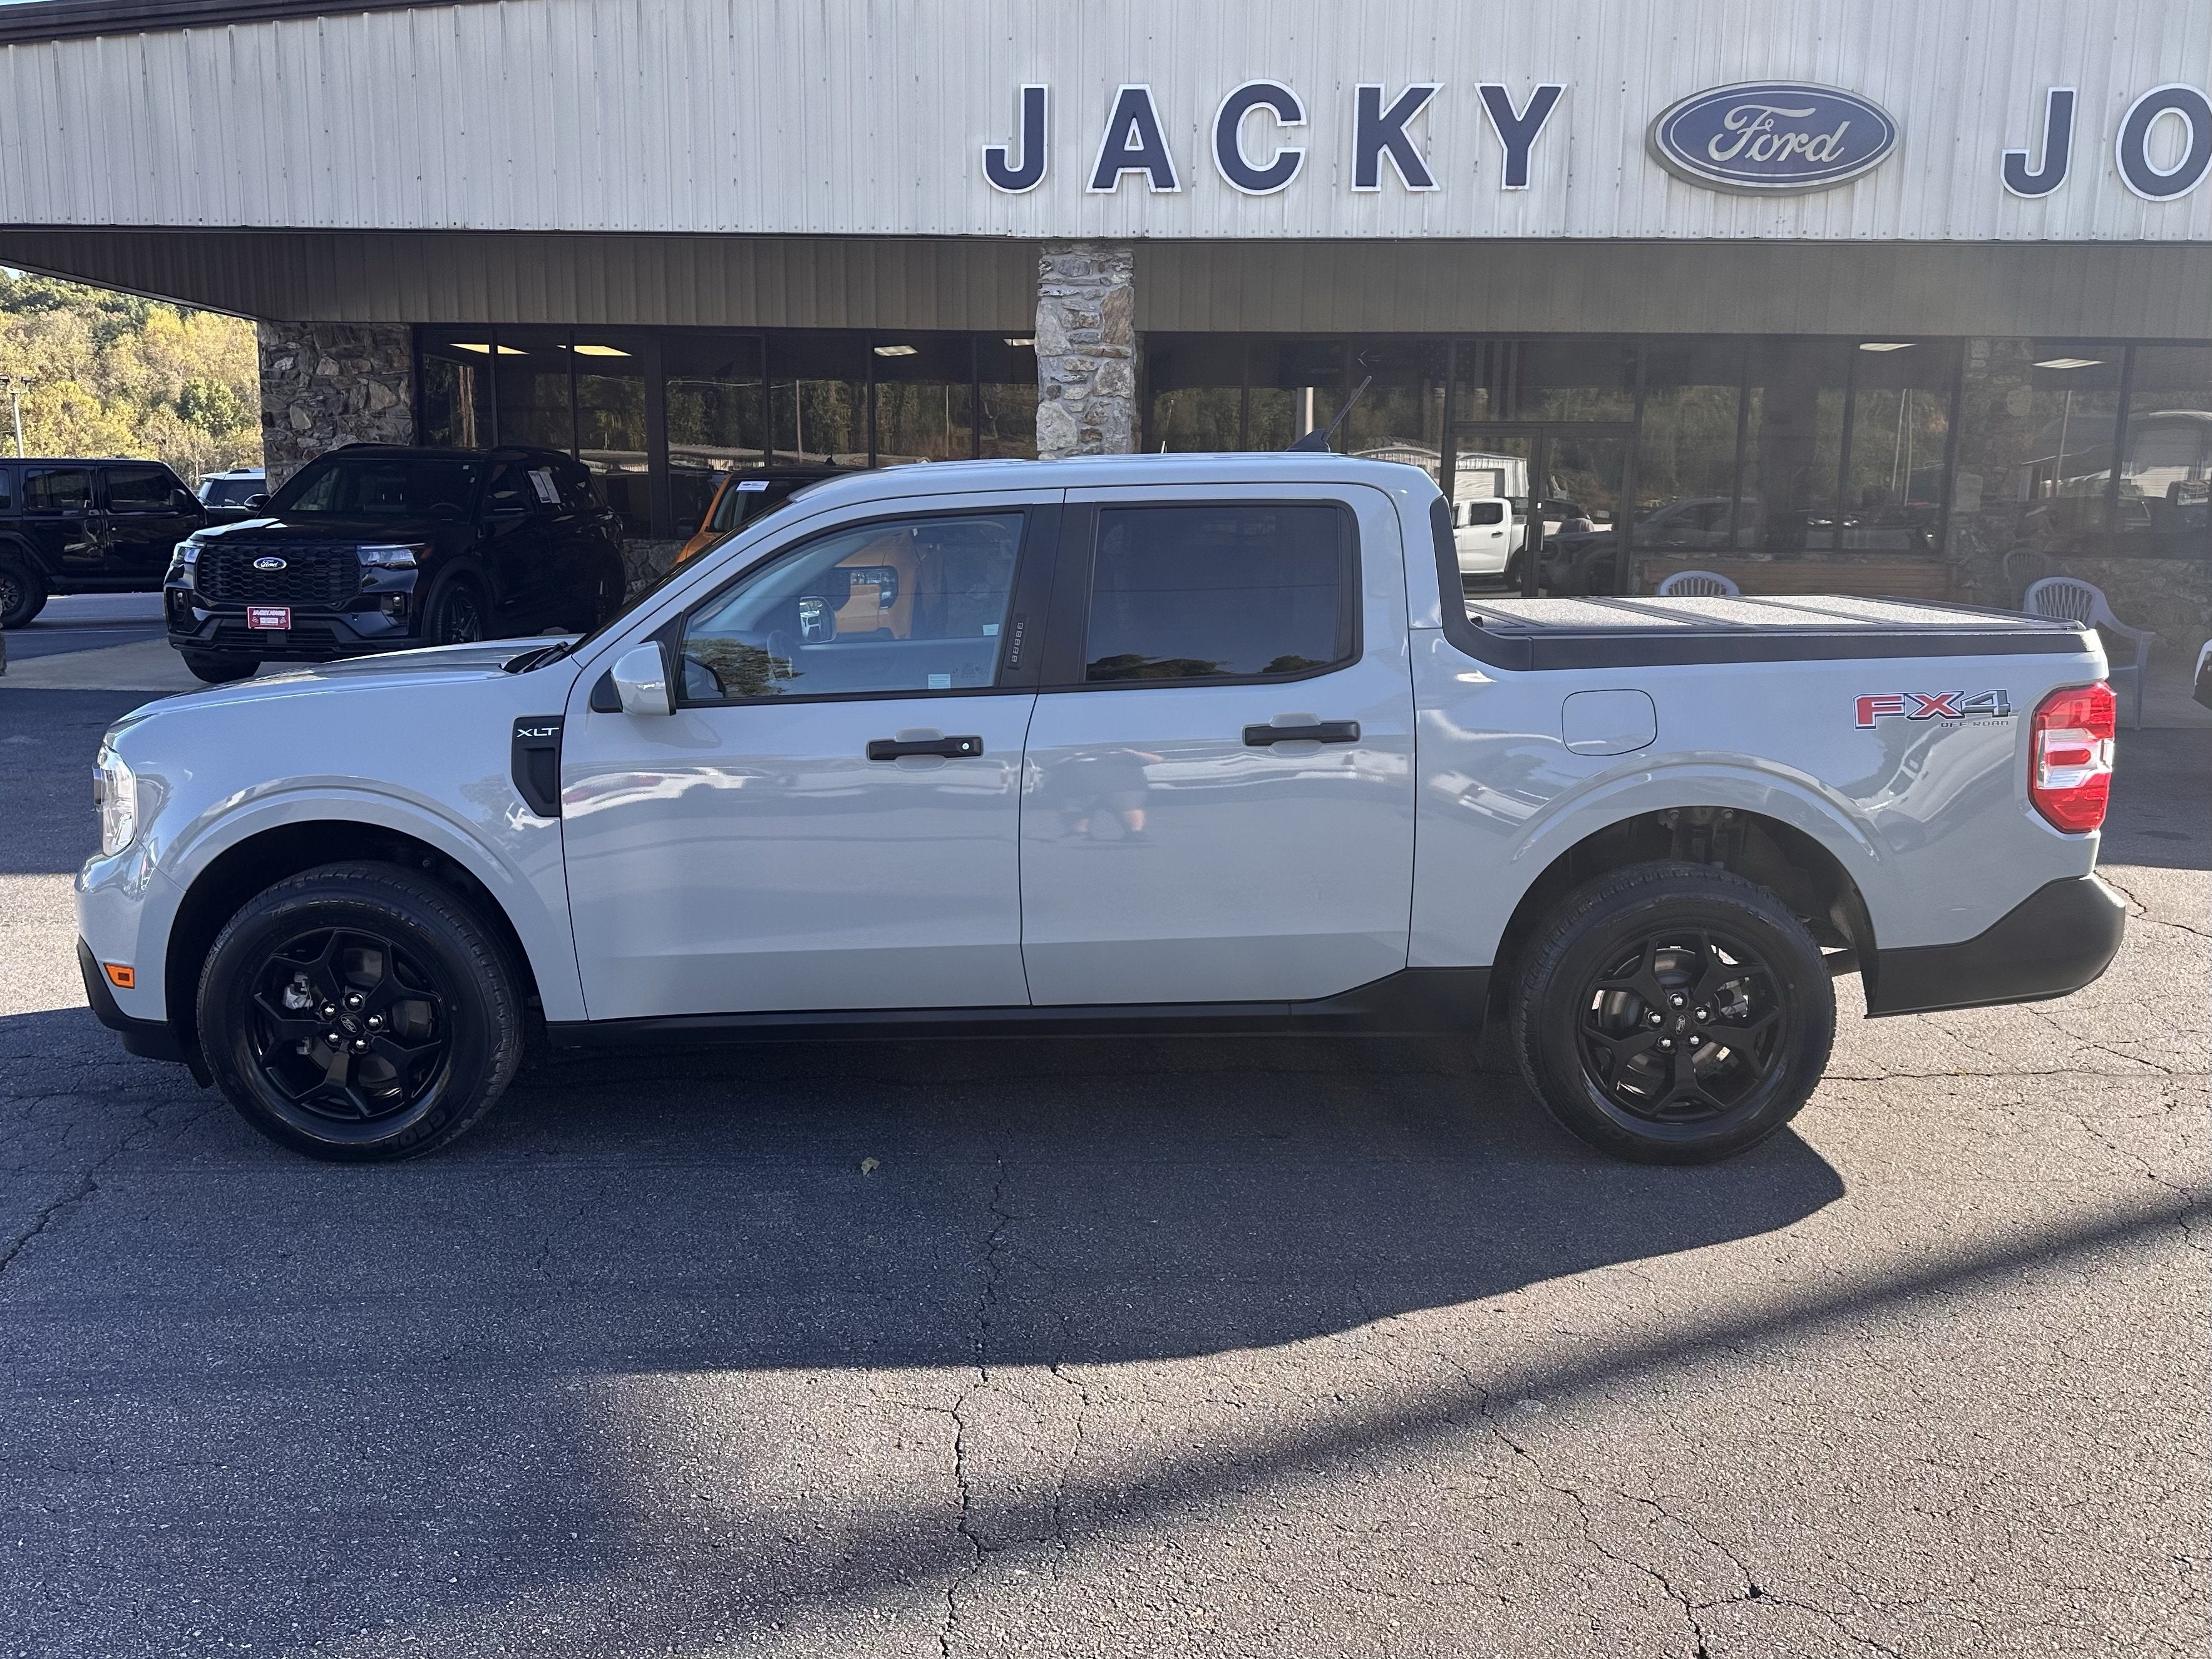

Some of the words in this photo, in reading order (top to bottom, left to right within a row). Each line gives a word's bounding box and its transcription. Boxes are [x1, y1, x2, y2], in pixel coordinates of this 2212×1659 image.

[982, 79, 1568, 194] JACKY
[1708, 105, 1851, 162] Ford
[2000, 83, 2212, 202] JO
[516, 727, 560, 737] XLT
[1852, 689, 2011, 731] FX4
